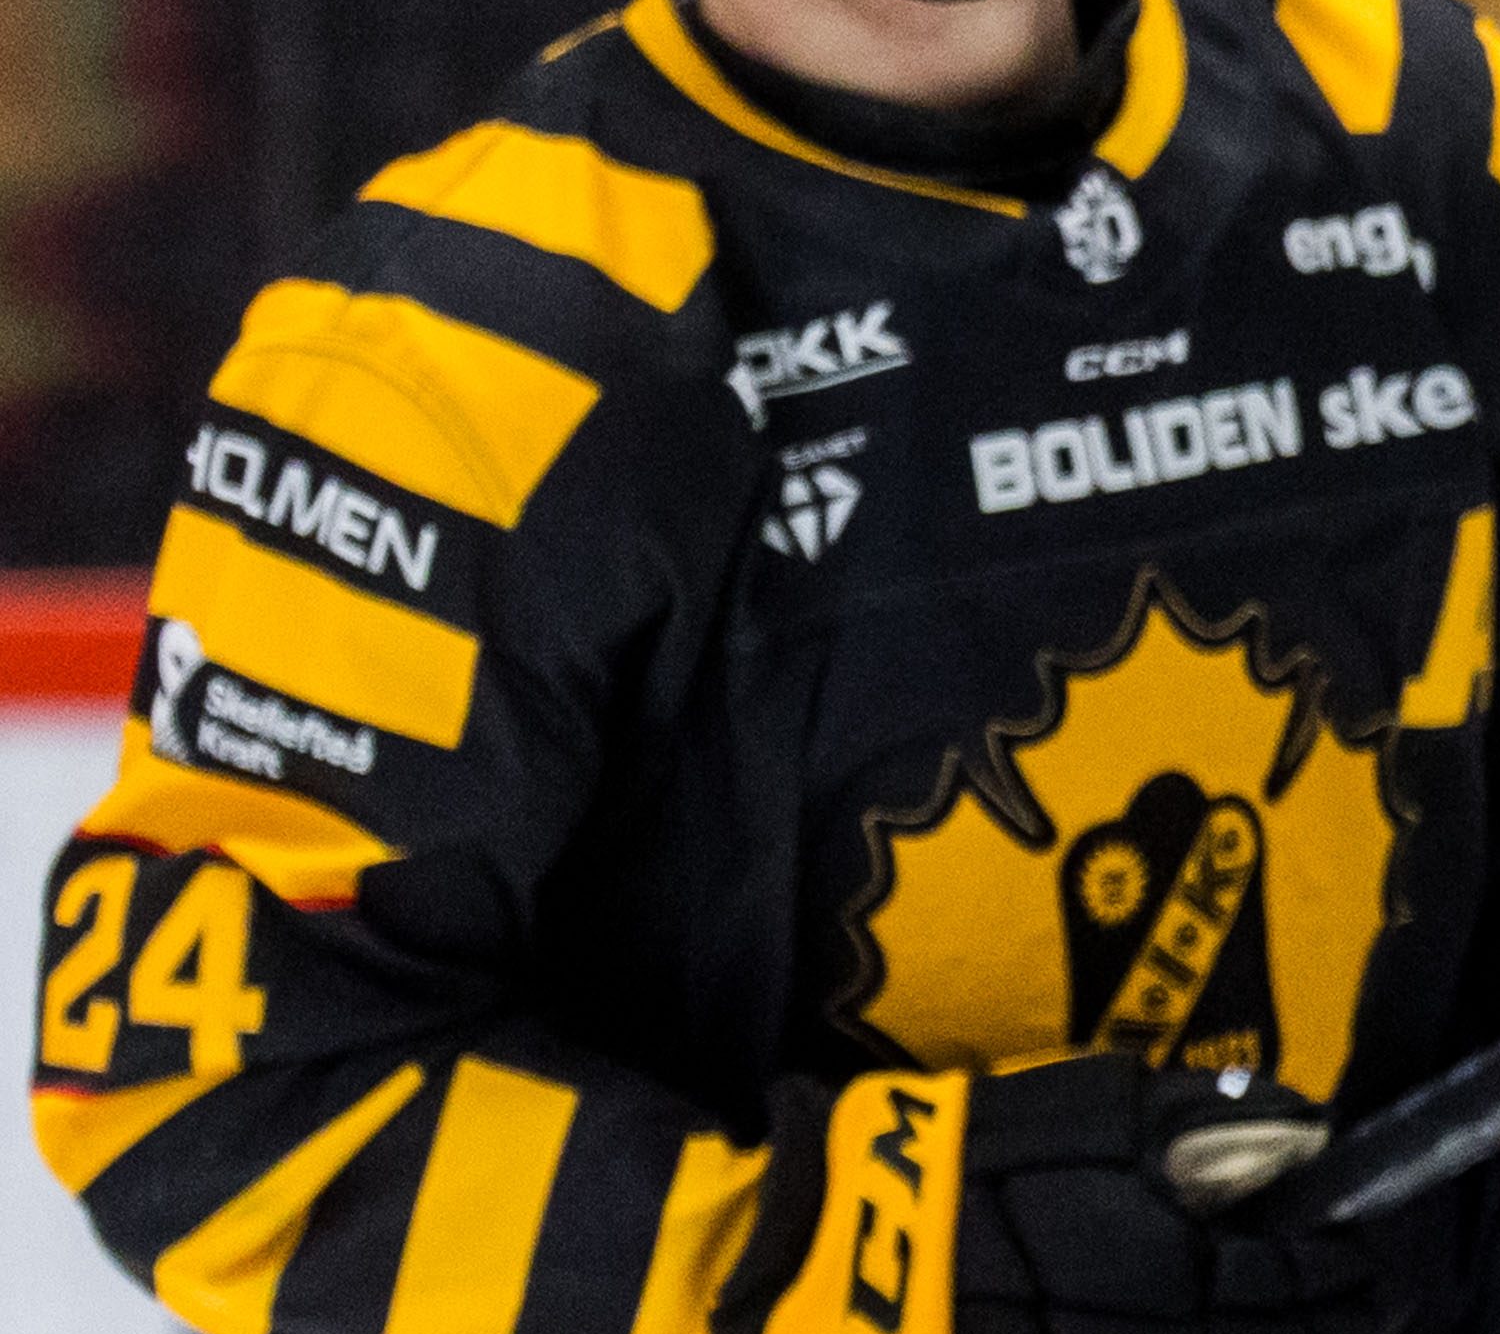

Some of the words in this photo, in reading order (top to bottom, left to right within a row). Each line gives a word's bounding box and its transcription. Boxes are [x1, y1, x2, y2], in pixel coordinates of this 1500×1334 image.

[1065, 328, 1190, 381] CCM
[969, 378, 1300, 514] BOLIDEN
[41, 856, 267, 1075] 24
